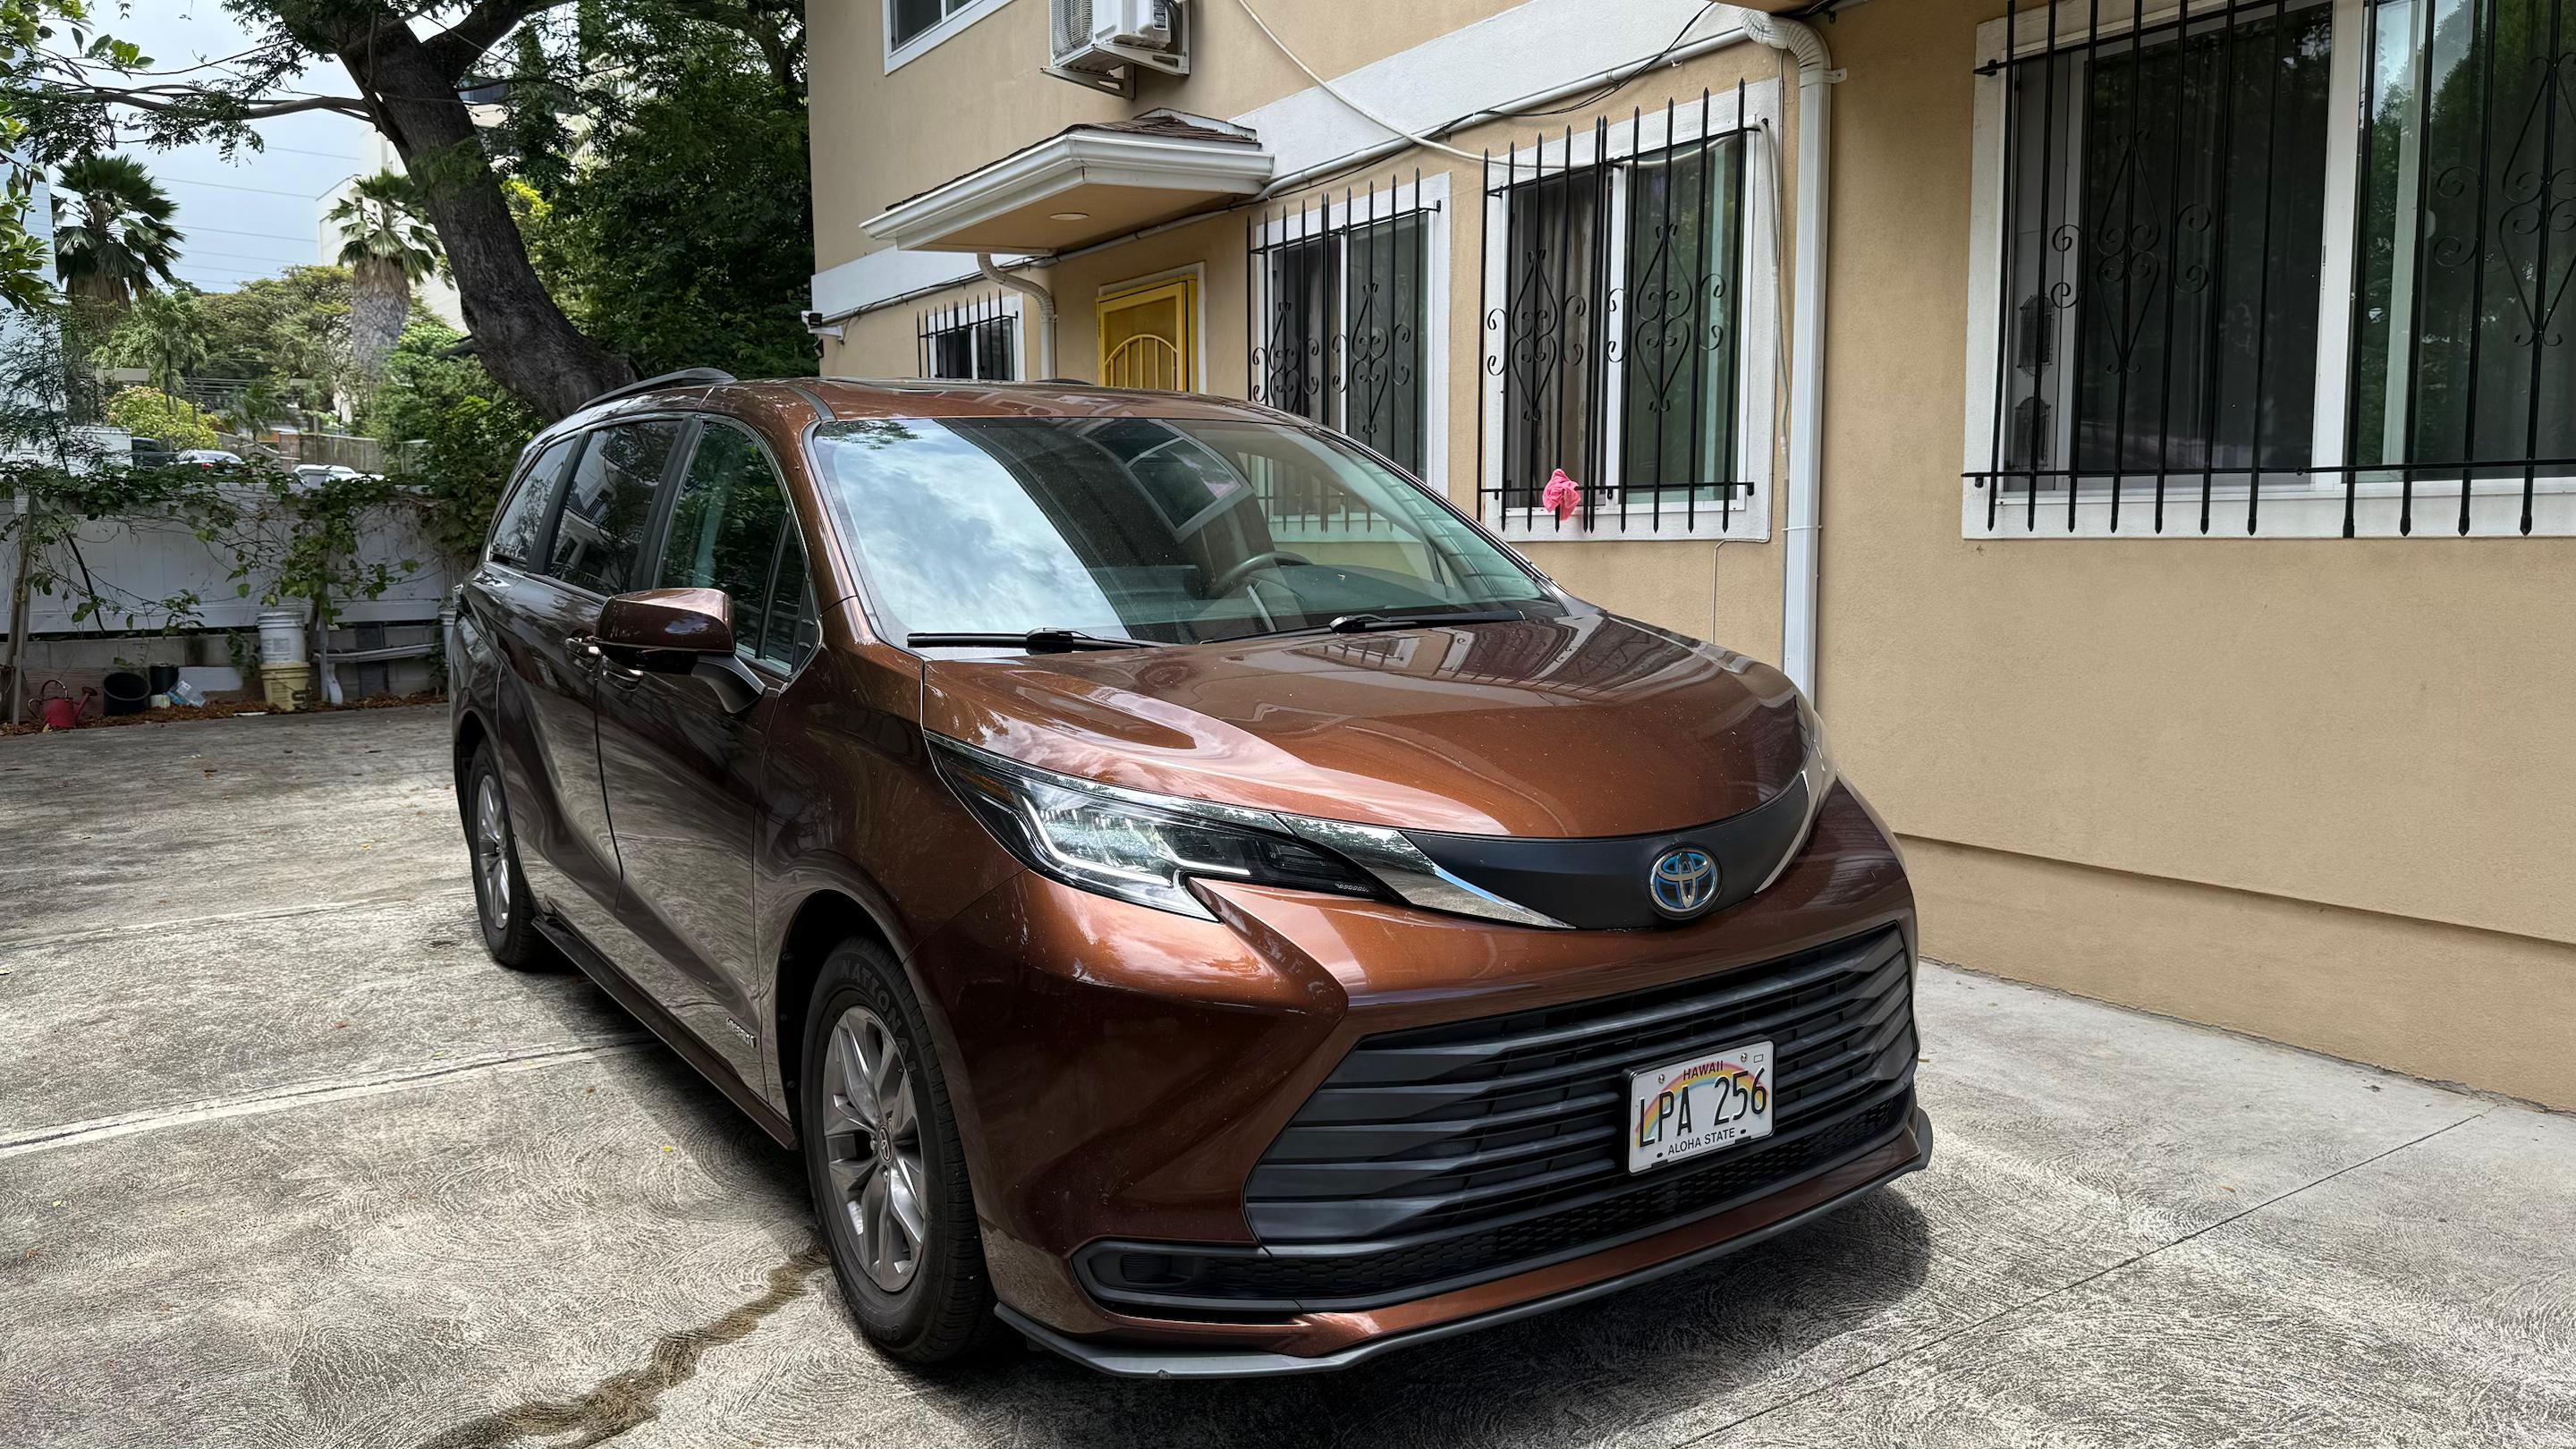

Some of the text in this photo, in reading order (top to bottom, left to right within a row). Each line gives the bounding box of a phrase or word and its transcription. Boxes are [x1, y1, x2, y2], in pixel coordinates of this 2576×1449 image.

[1682, 1061, 1724, 1080] HAWAII
[1640, 1066, 1767, 1148] LPA 256
[1667, 1128, 1735, 1156] ALOHA STATE
